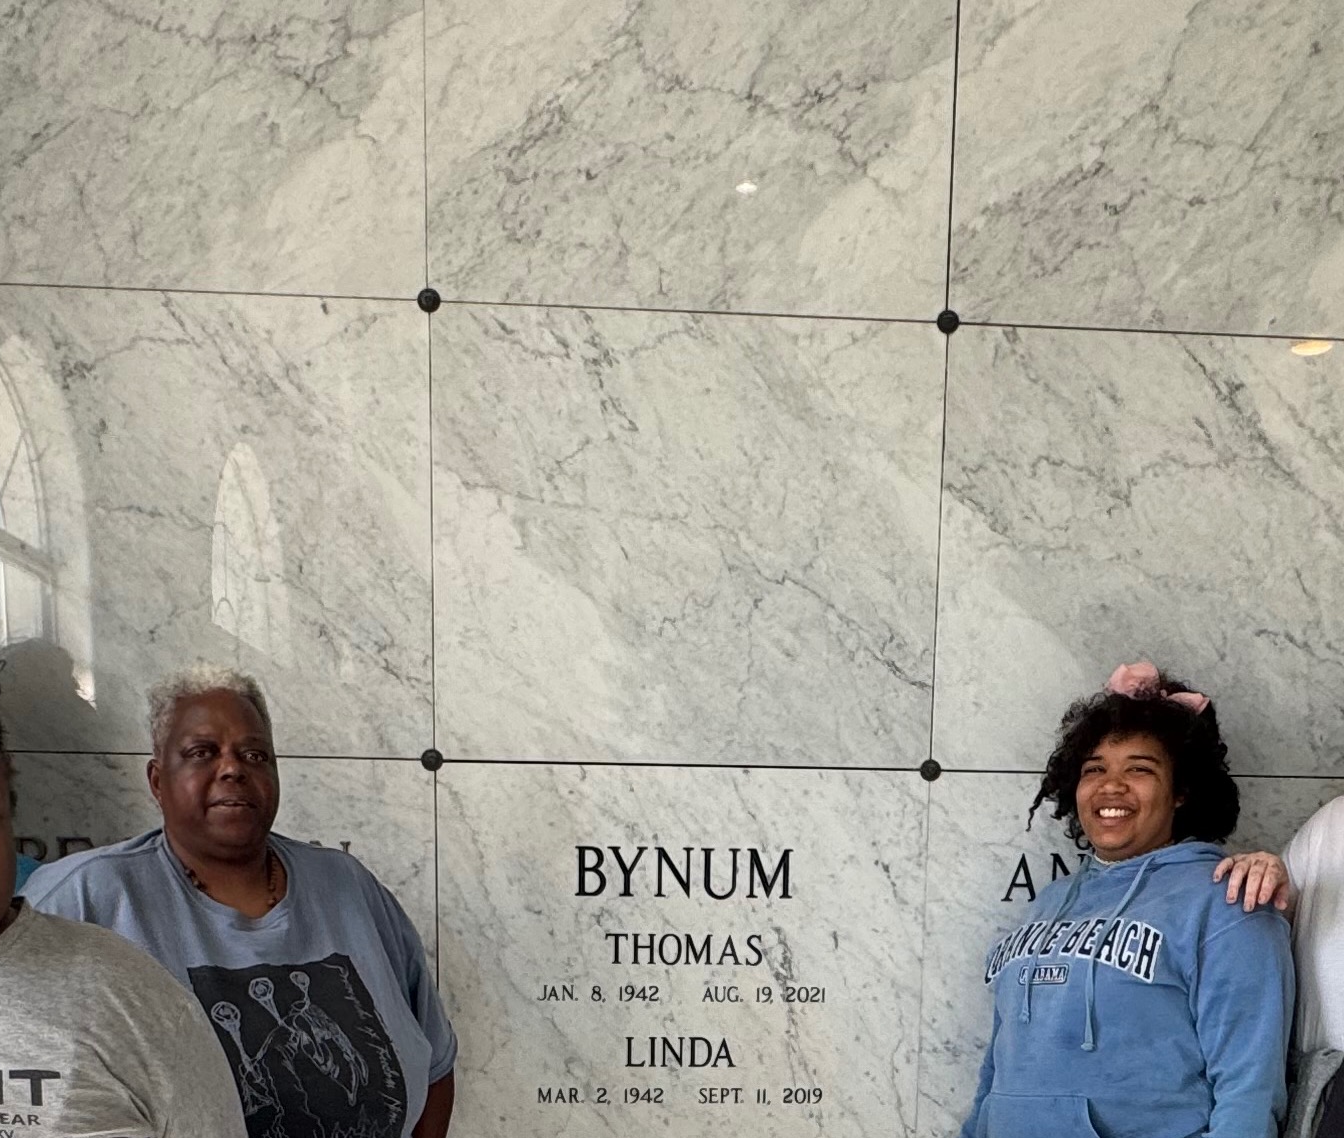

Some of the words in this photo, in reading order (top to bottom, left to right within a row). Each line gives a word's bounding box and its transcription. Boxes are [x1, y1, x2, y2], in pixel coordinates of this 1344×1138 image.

[574, 846, 794, 900] BYNUM
[605, 933, 764, 966] THOMAS
[1060, 917, 1163, 984] BEACH
[1020, 966, 1066, 982] AABAMA
[537, 984, 579, 1002] JAN.
[591, 985, 606, 1003] 8,
[619, 985, 659, 1002] 1942
[702, 986, 744, 1003] AUG.
[756, 986, 774, 1005] 19,
[785, 986, 826, 1003] 2021
[625, 1036, 736, 1068] LINDA
[537, 1087, 584, 1104] MAR.
[596, 1087, 611, 1105] 2,
[624, 1087, 664, 1104] 1942
[698, 1087, 744, 1104] SEPT.
[756, 1087, 771, 1106] 11,
[782, 1087, 823, 1104] 2019
